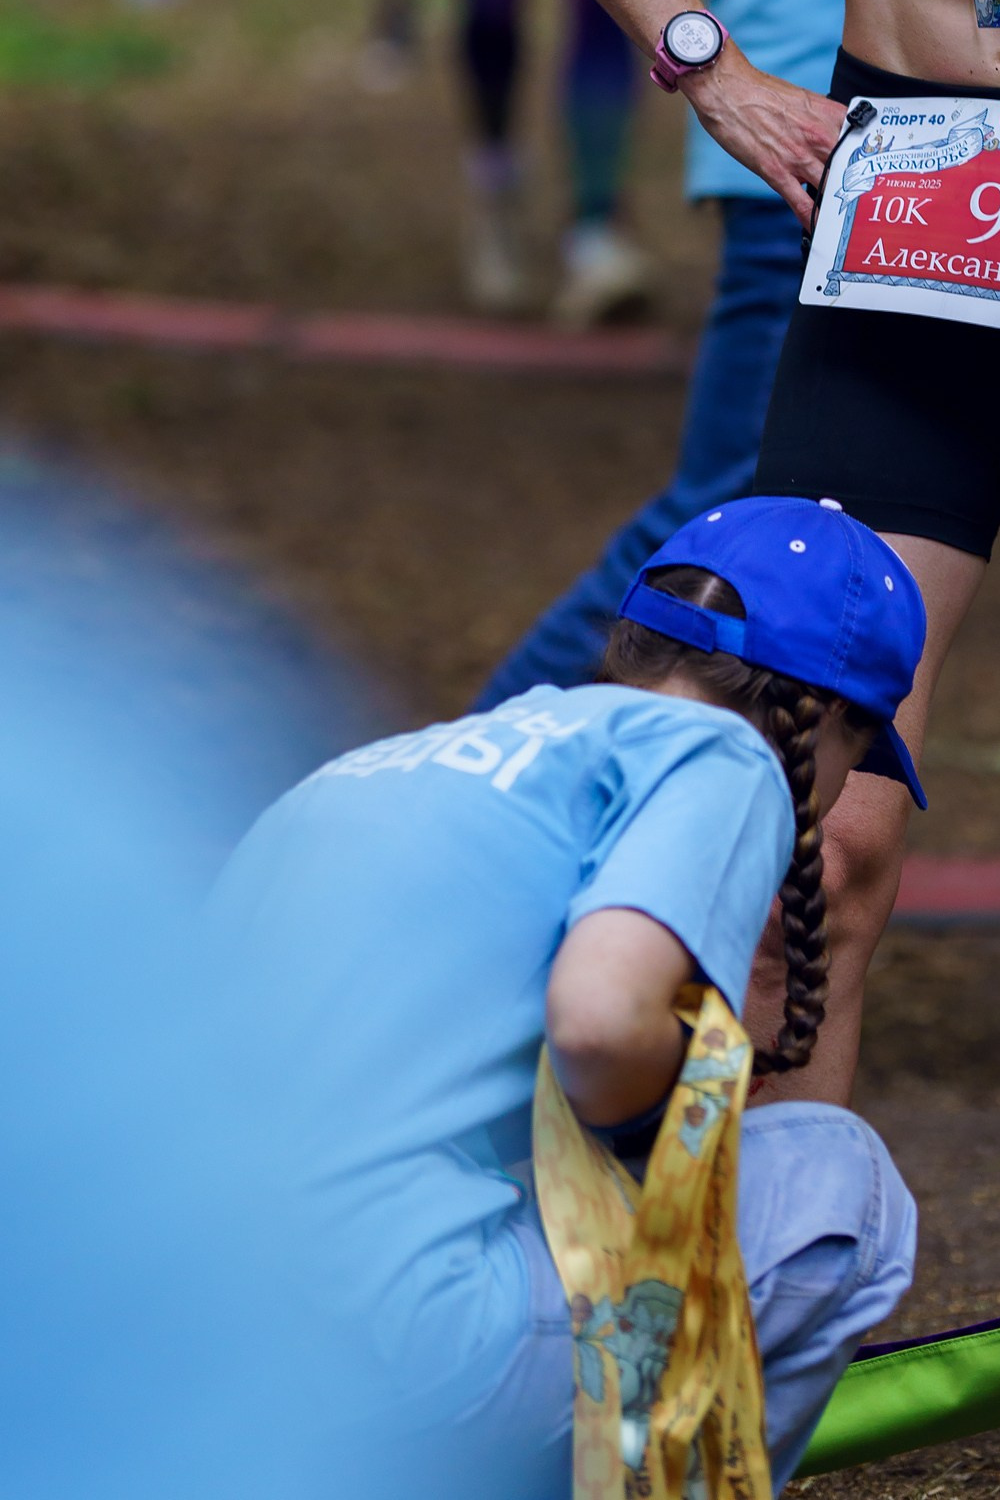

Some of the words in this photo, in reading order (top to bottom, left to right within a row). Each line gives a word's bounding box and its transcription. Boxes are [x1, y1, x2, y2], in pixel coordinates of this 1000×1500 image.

[882, 106, 900, 114] PRO
[880, 114, 927, 126] СПОРТ
[928, 114, 945, 125] 40
[862, 146, 970, 175] Лукоморье
[877, 177, 886, 186] 7
[886, 179, 917, 189] июня
[918, 178, 943, 190] 2025
